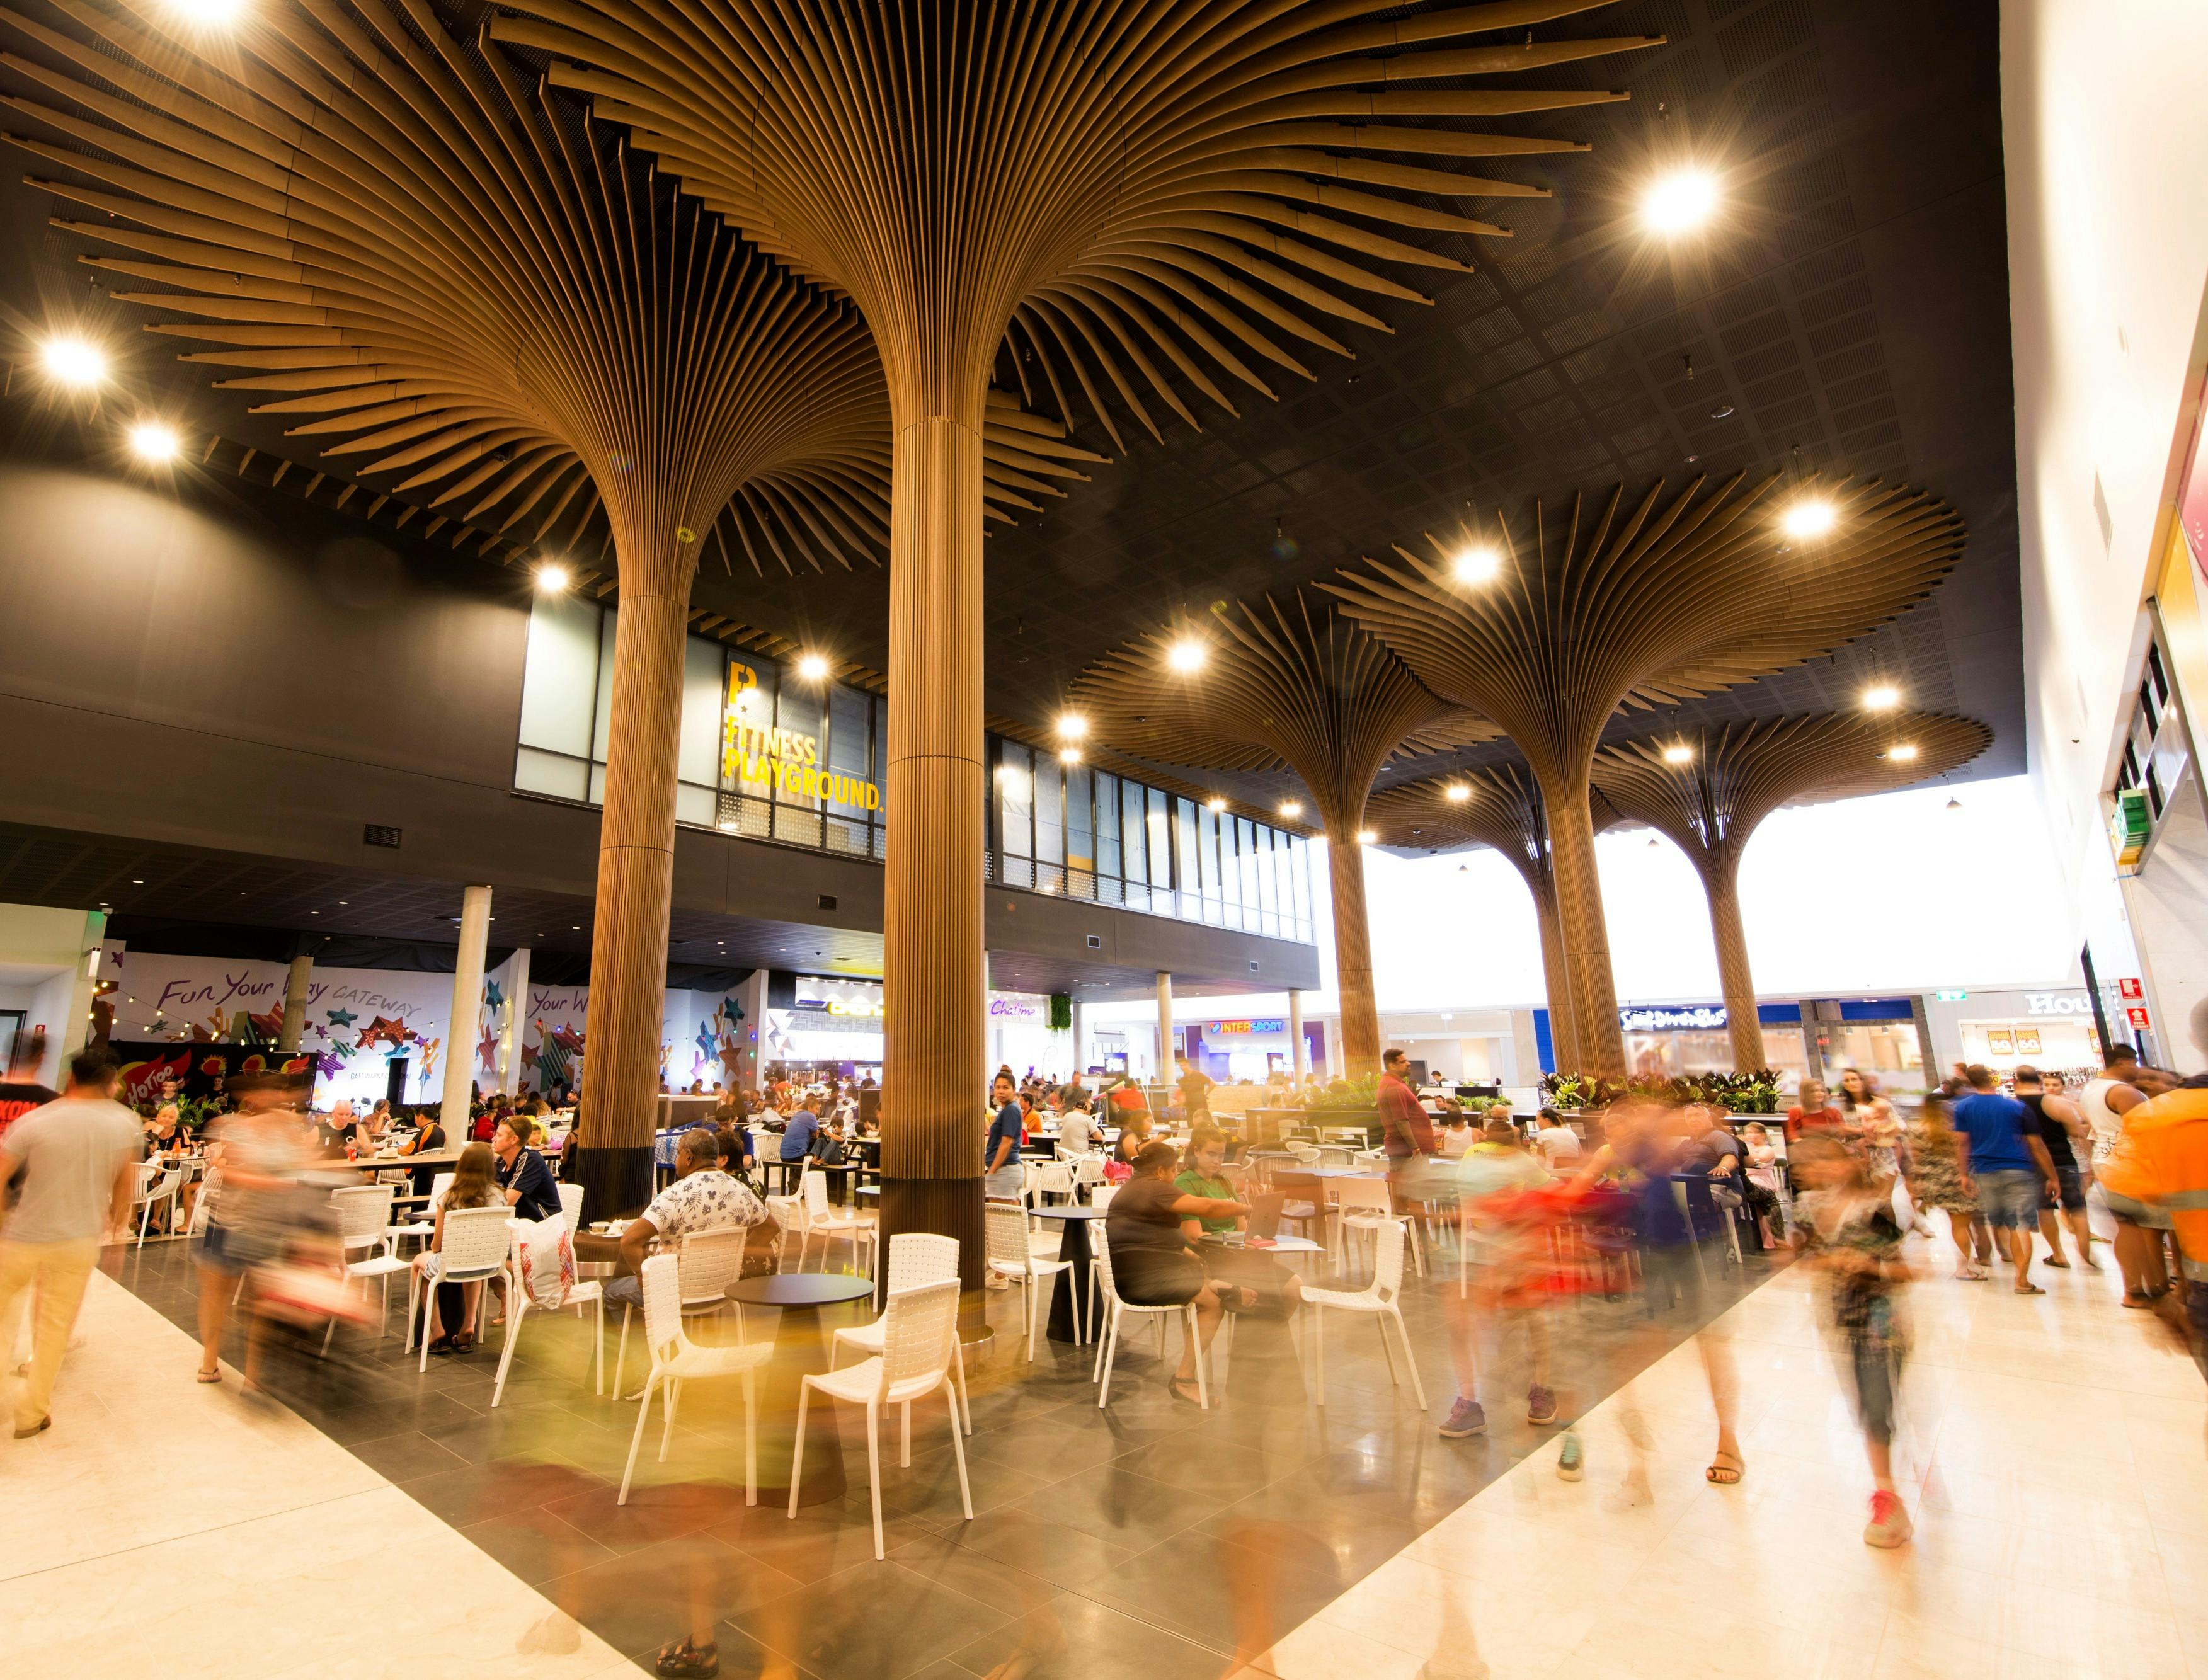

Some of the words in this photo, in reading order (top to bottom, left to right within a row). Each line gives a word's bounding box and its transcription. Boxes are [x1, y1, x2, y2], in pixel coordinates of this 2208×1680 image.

[726, 715, 816, 766] FITNESS
[156, 980, 215, 1010] Fun
[215, 970, 274, 1005] Your
[332, 985, 422, 1018] GATEWAY
[528, 989, 568, 1019] Your
[1222, 1021, 1283, 1034] INTERSPORT
